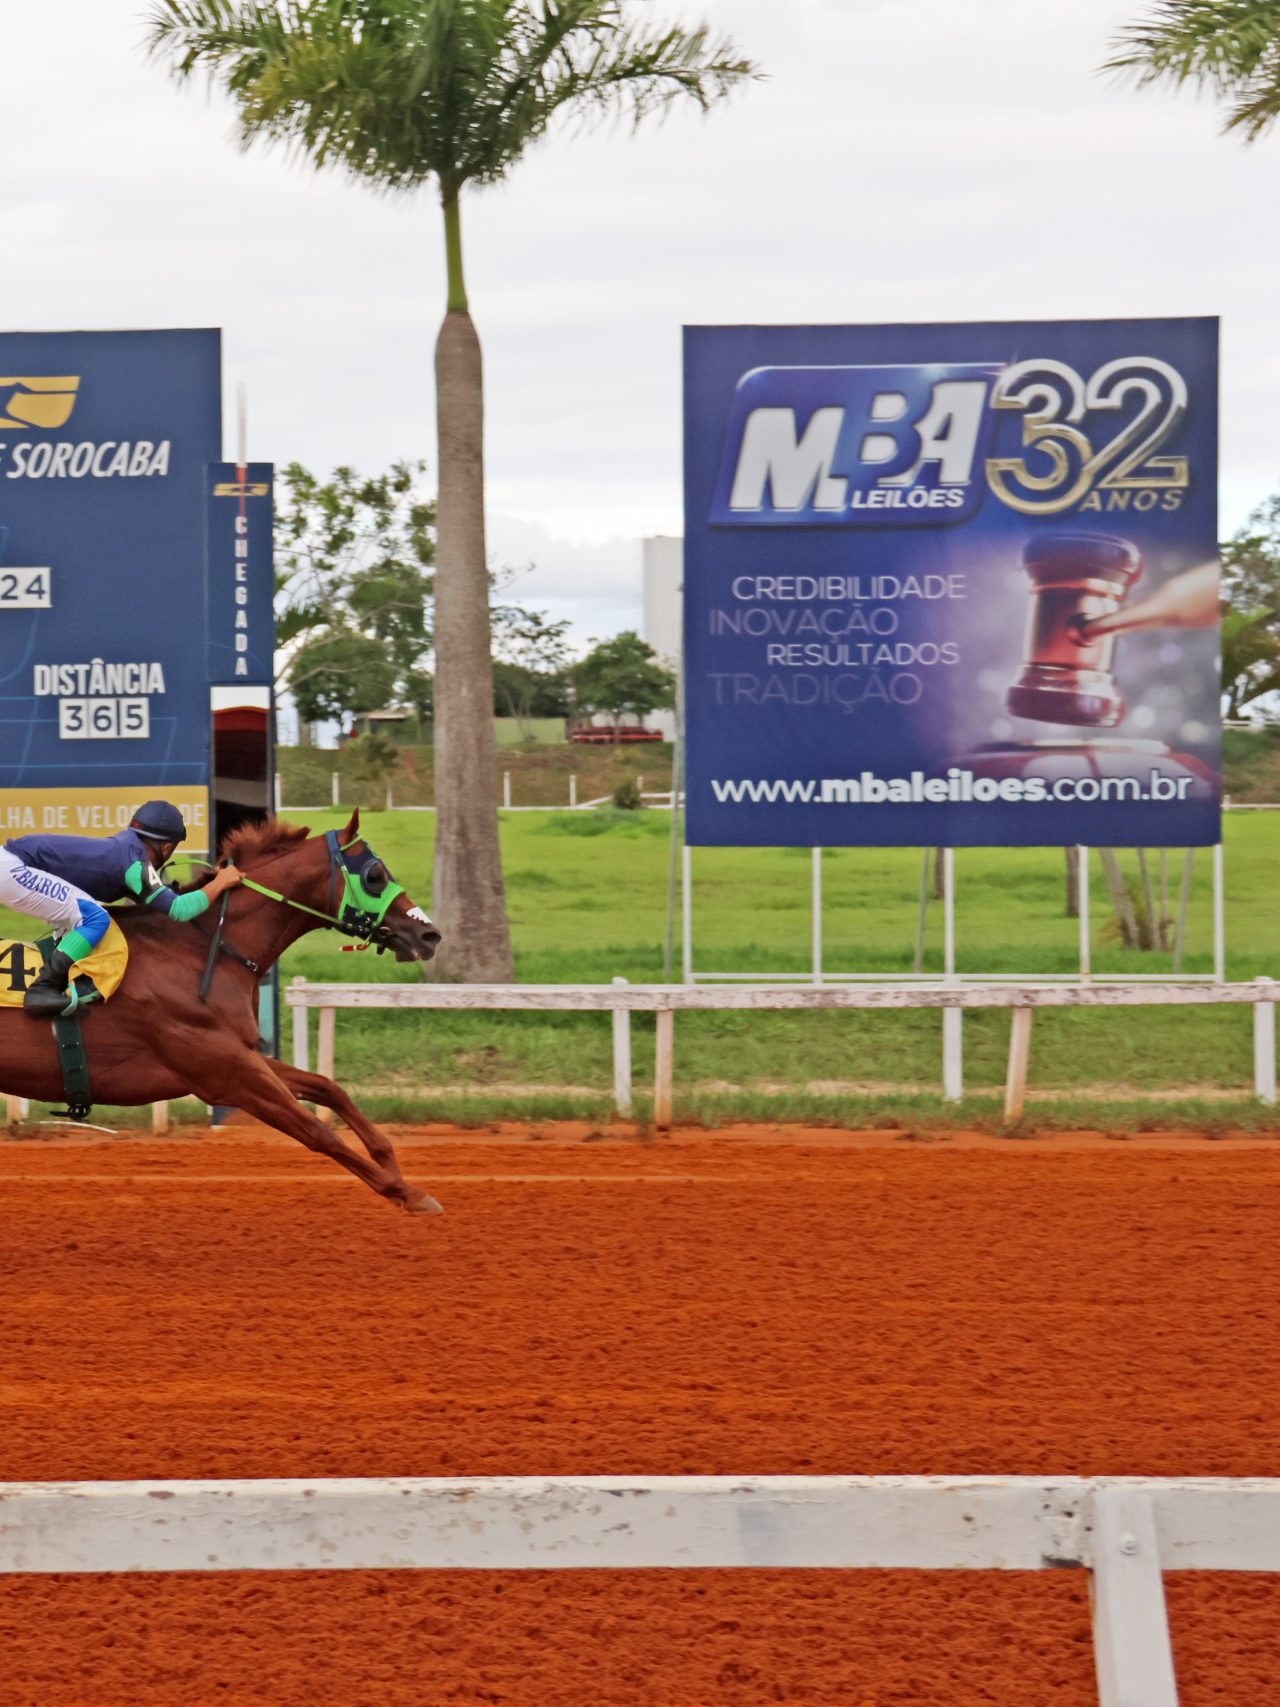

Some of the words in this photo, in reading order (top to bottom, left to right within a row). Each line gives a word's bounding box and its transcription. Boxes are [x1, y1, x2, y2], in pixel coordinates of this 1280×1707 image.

[729, 380, 988, 513] MBA
[984, 356, 1189, 515] 32
[6, 440, 171, 478] SOROCABA
[851, 486, 965, 510] LEILÕES
[1078, 488, 1185, 512] ANOS
[234, 516, 249, 676] CHEGADA
[731, 574, 968, 601] CREDIBILIDADE
[708, 603, 899, 643] INOVAÇÃO
[766, 642, 961, 666] RESULTADOS
[33, 658, 166, 696] DISTÂNCIA
[705, 667, 924, 714] TRADIÇÃO
[65, 704, 144, 732] 365
[711, 768, 1194, 803] www.mbaleiloes.com.br
[43, 805, 70, 829] DE
[76, 803, 205, 828] VELODE
